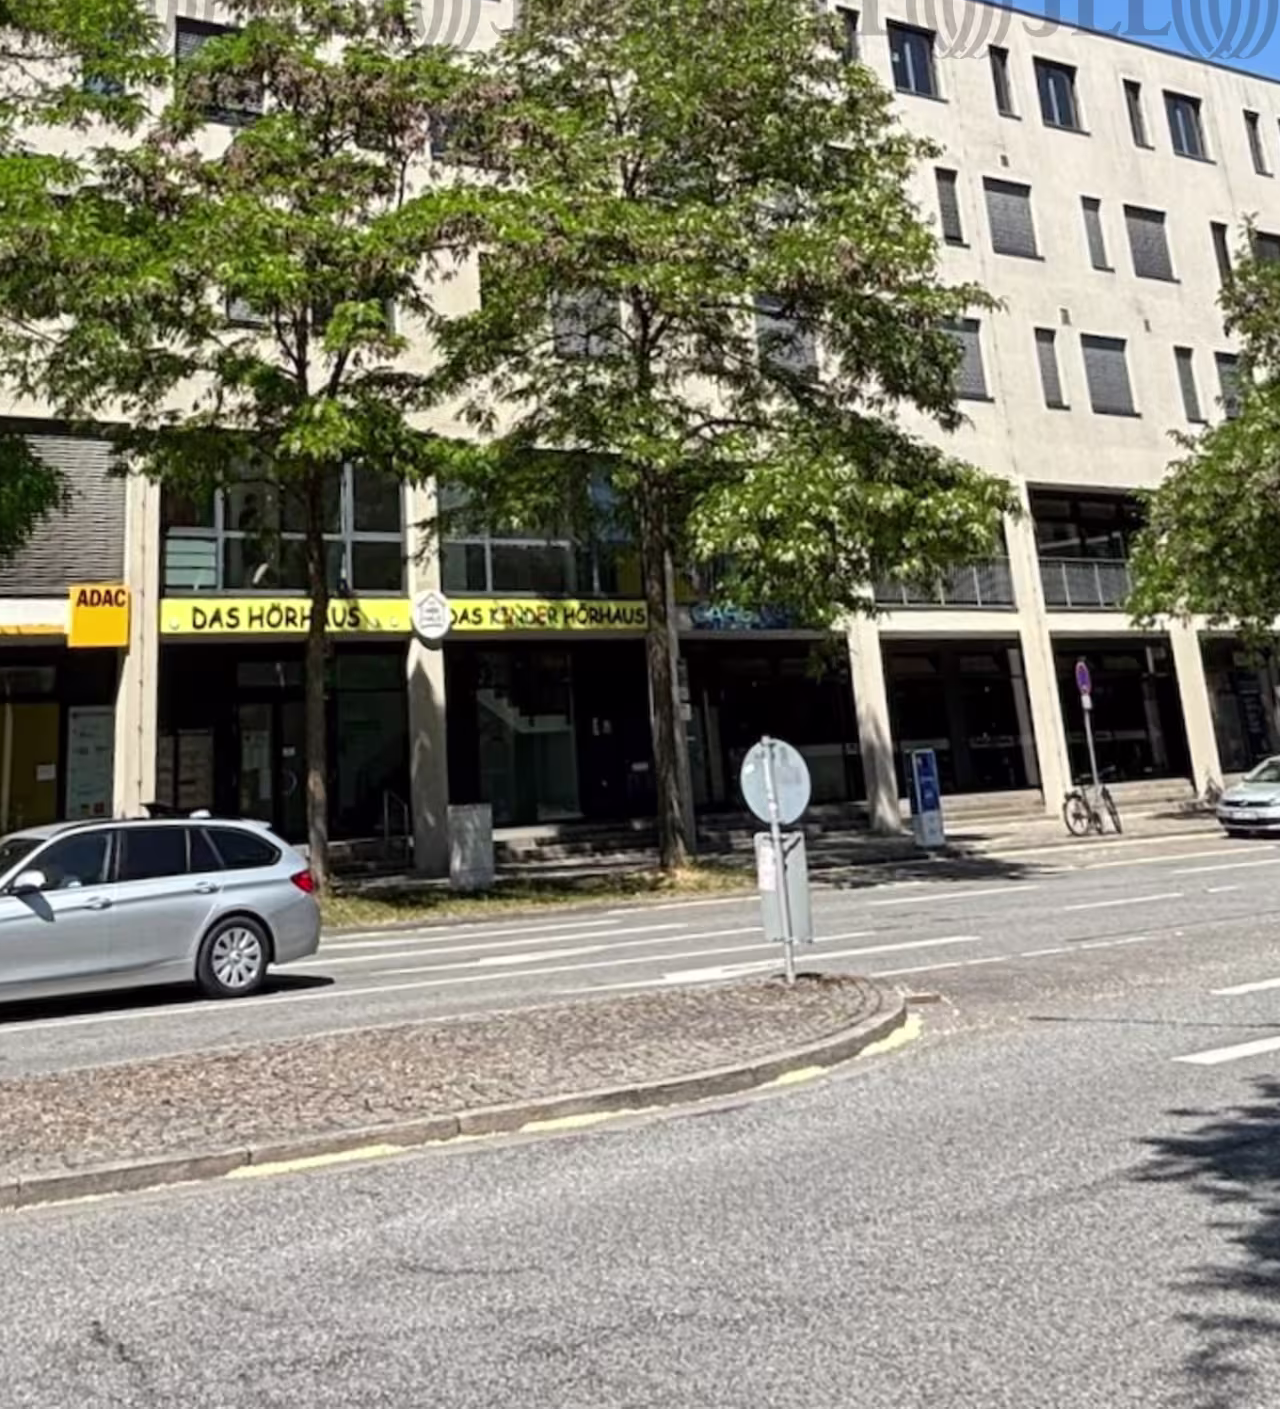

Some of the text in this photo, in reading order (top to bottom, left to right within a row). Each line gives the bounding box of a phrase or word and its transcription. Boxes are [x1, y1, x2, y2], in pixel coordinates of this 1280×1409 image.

[76, 589, 126, 607] ADAC
[192, 603, 360, 629] DAS HÖRHUS
[490, 605, 558, 626] KINDER
[564, 603, 646, 625] HÖRHAUS
